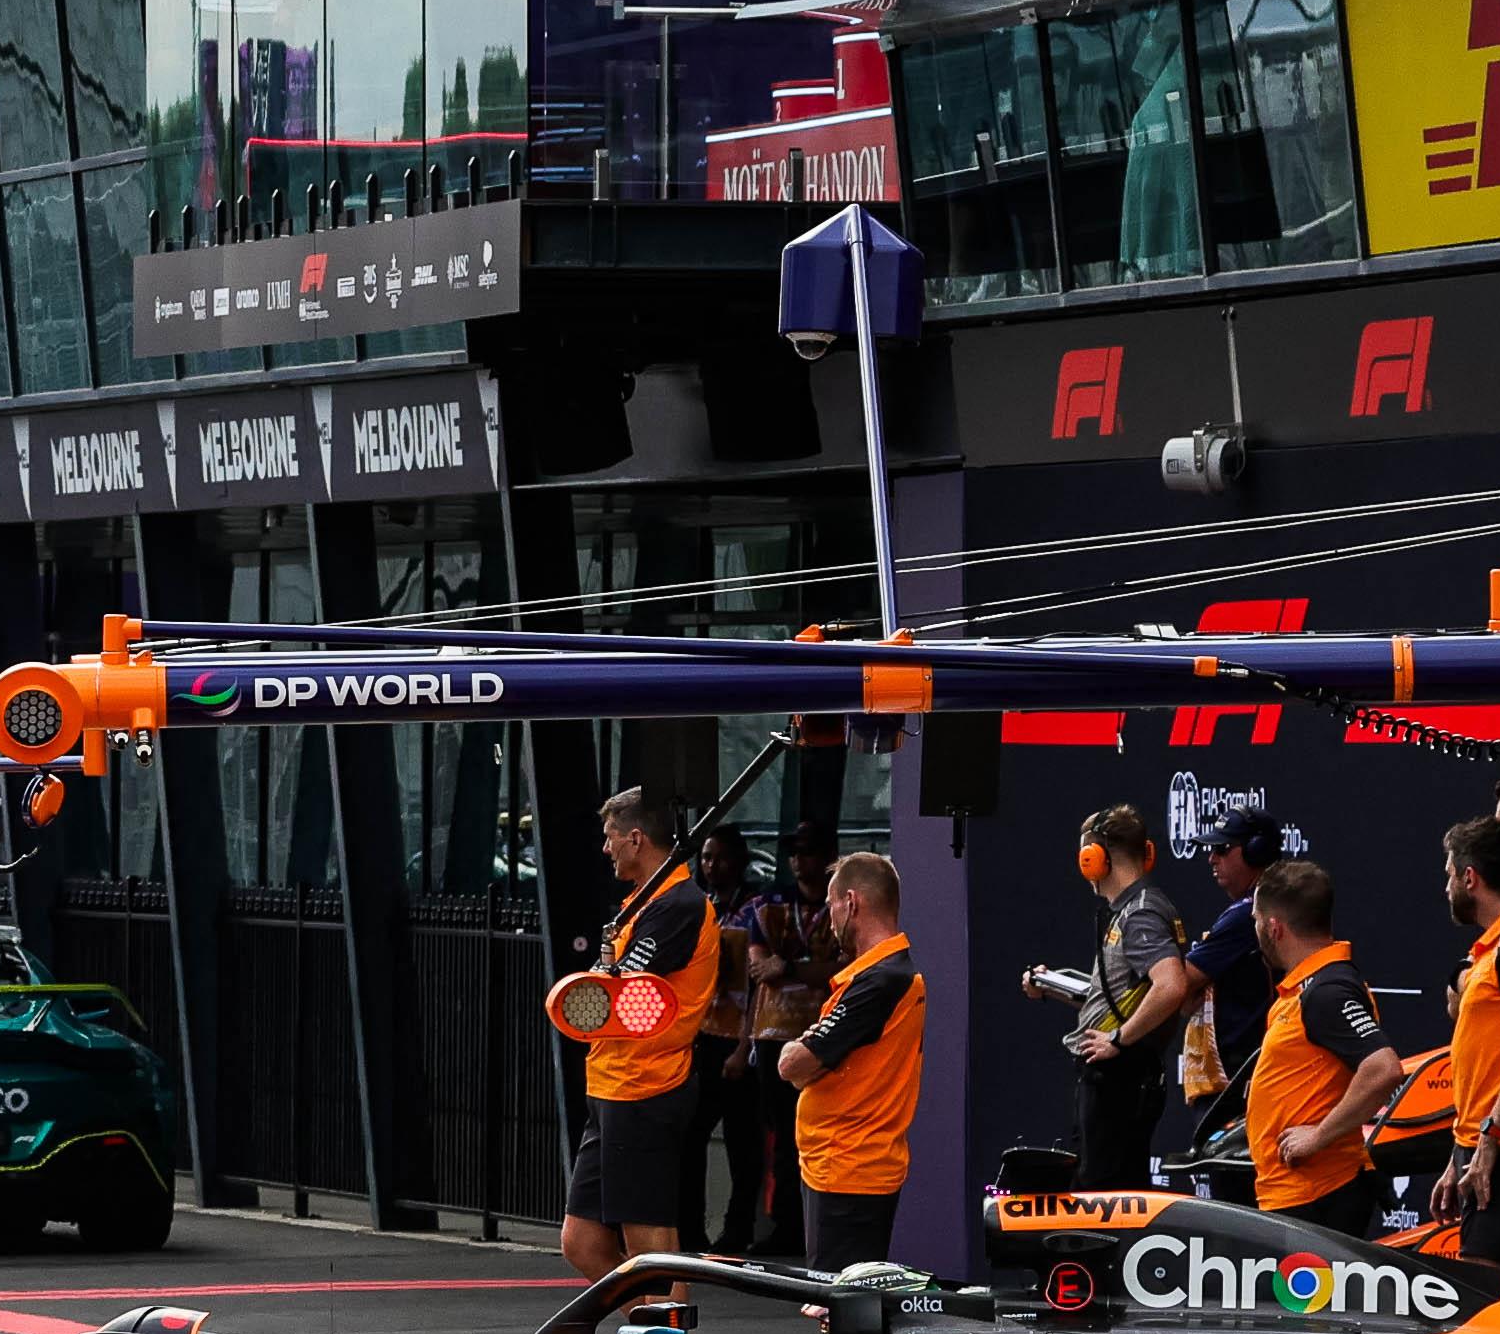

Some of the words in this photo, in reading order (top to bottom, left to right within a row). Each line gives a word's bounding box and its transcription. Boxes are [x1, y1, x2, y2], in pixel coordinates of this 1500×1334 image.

[724, 149, 775, 201] MOËT
[806, 146, 886, 201] HANDON
[51, 431, 144, 495] MELBOURNE
[200, 415, 300, 483] MELBOURNE
[353, 403, 463, 473] MELBOURNE
[255, 675, 316, 708] DP
[326, 672, 504, 706] WORLD
[1003, 1196, 1148, 1230] allwyn
[900, 1296, 944, 1313] okta
[1123, 1234, 1460, 1320] Chrome
